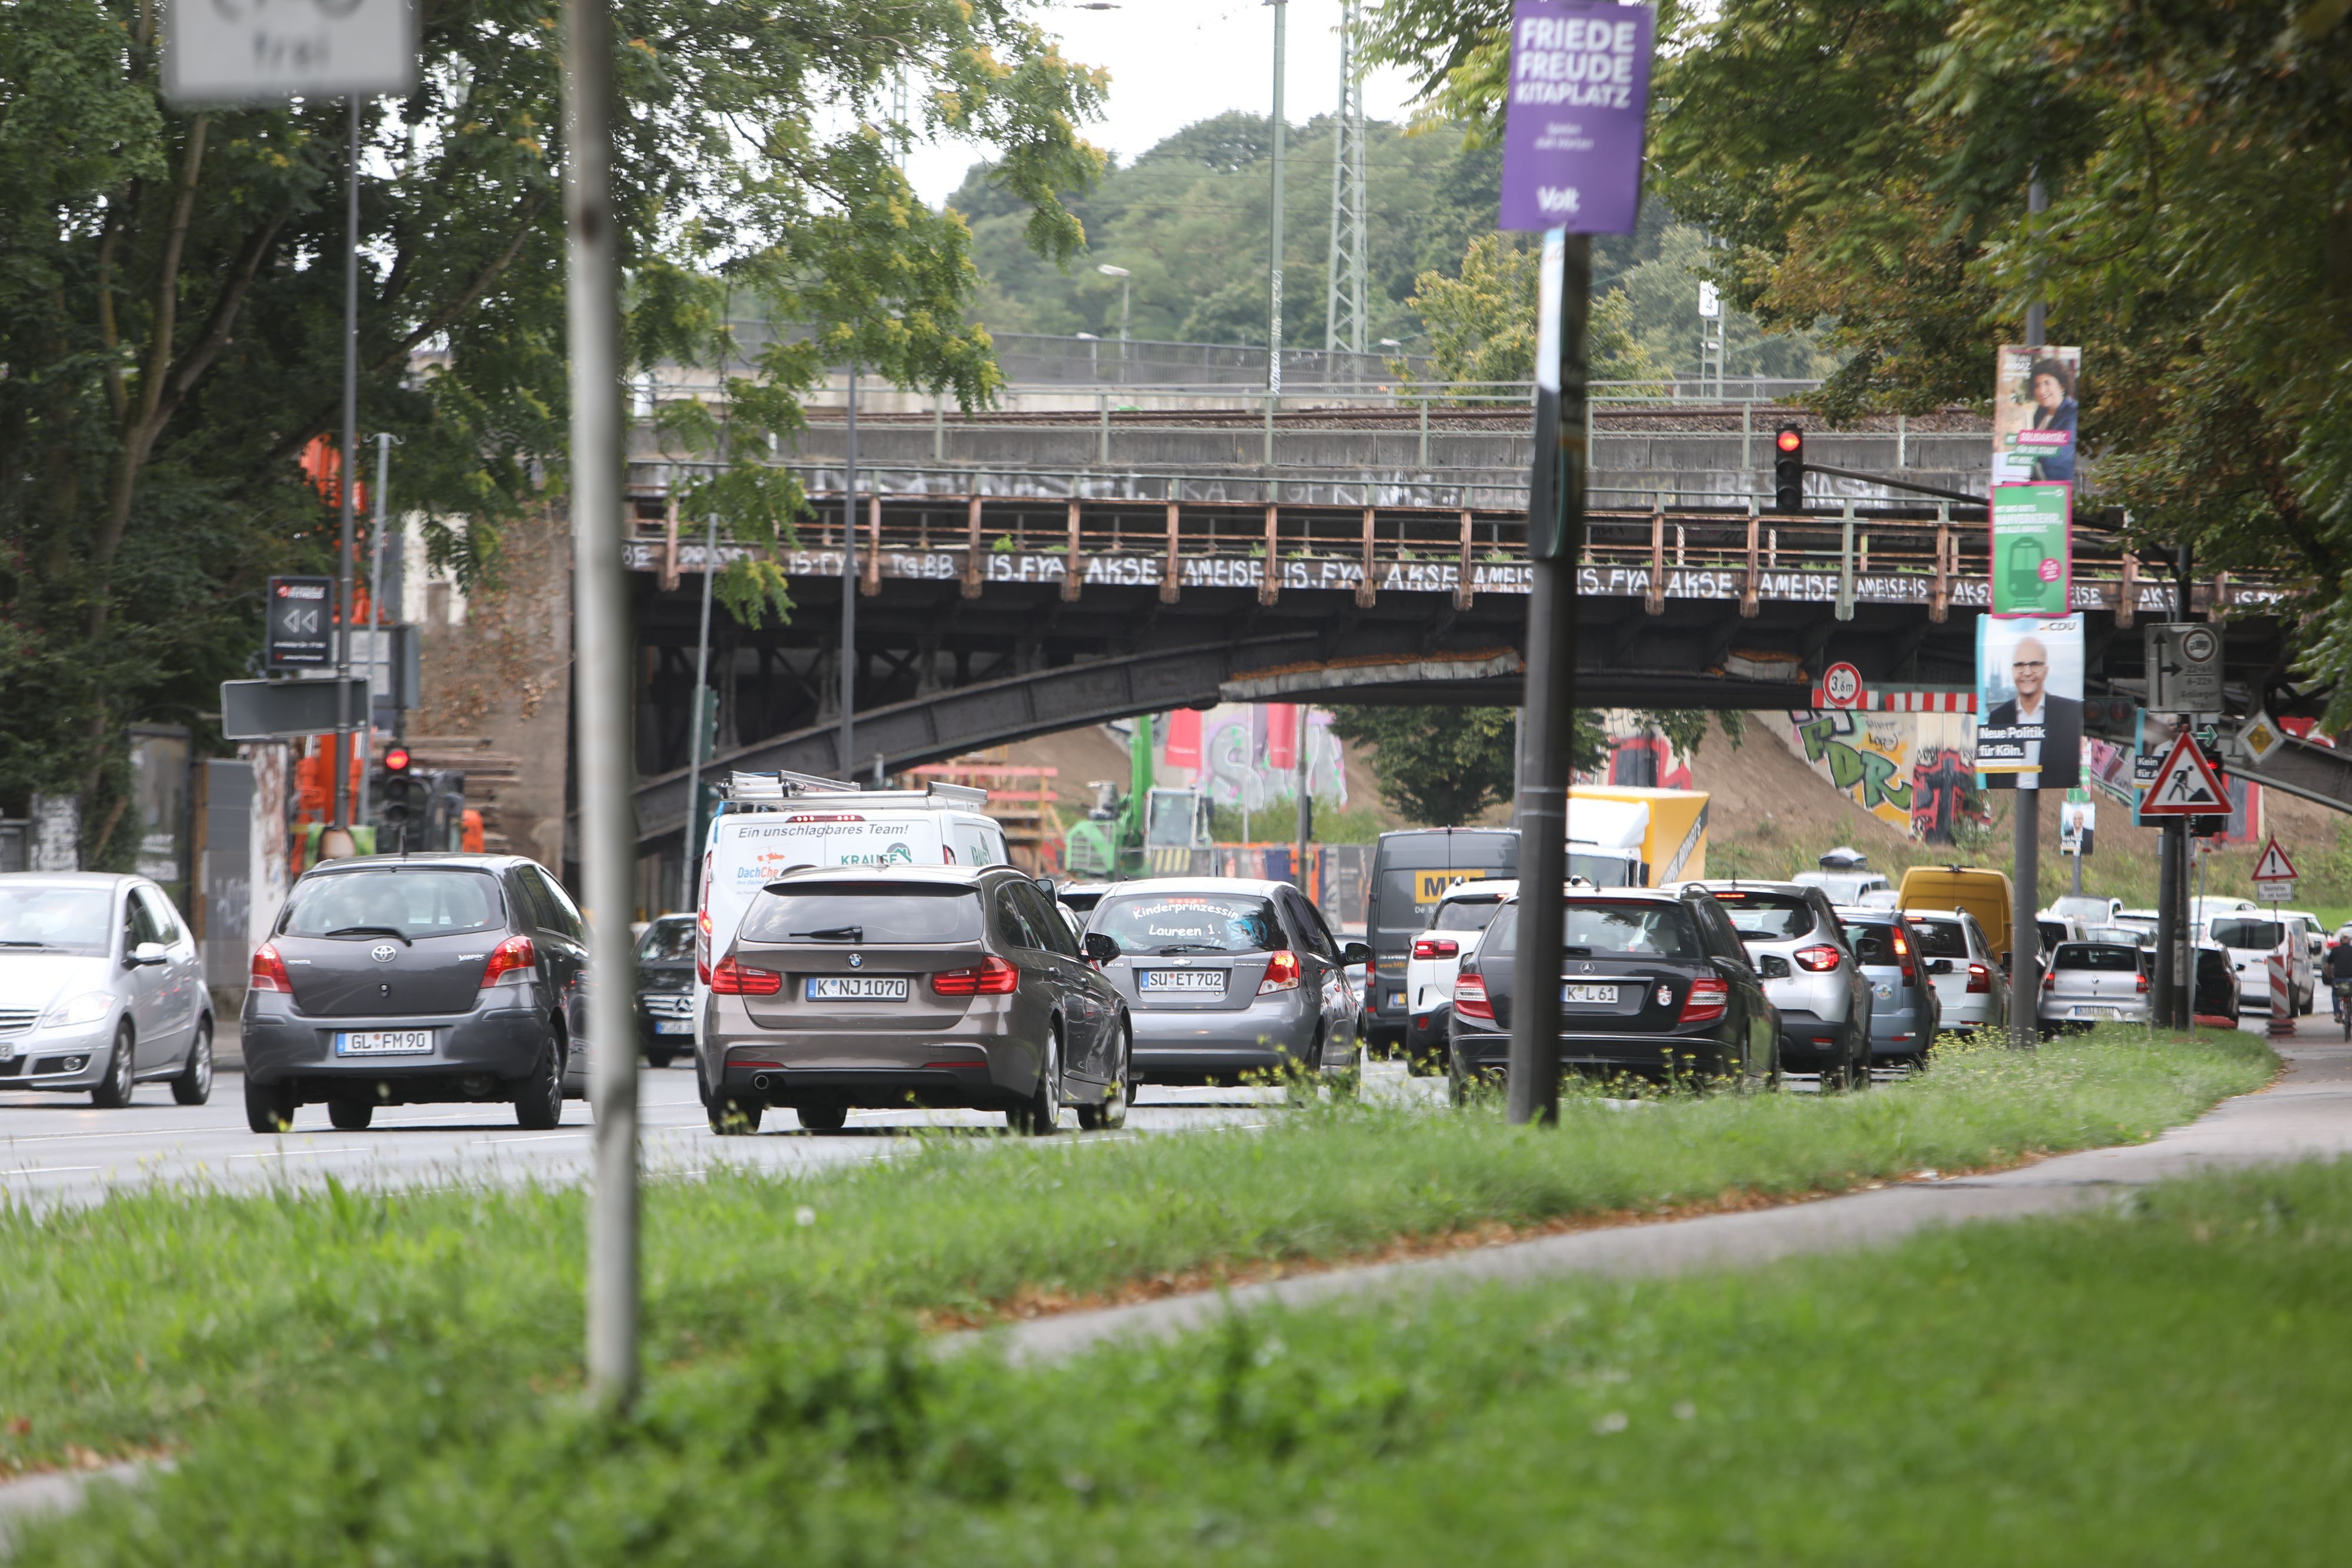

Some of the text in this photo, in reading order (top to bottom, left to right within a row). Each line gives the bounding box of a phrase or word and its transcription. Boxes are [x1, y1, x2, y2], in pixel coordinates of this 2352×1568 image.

[1519, 17, 1637, 54] FRIEDE
[1516, 52, 1634, 84] FREUDE
[1514, 82, 1632, 109] KITAPLATZ
[1536, 186, 1581, 212] Volt
[2048, 621, 2077, 631] CDU
[1979, 727, 2046, 740] Neue Politik
[1978, 744, 2024, 757] für Köln.
[2137, 757, 2159, 766] Kein
[2137, 768, 2151, 778] für
[738, 824, 909, 838] Ein unschlagbares Team!
[1132, 902, 1240, 920] Kinderprinzessin
[1148, 924, 1201, 937] Laureen
[352, 1034, 372, 1049] GL
